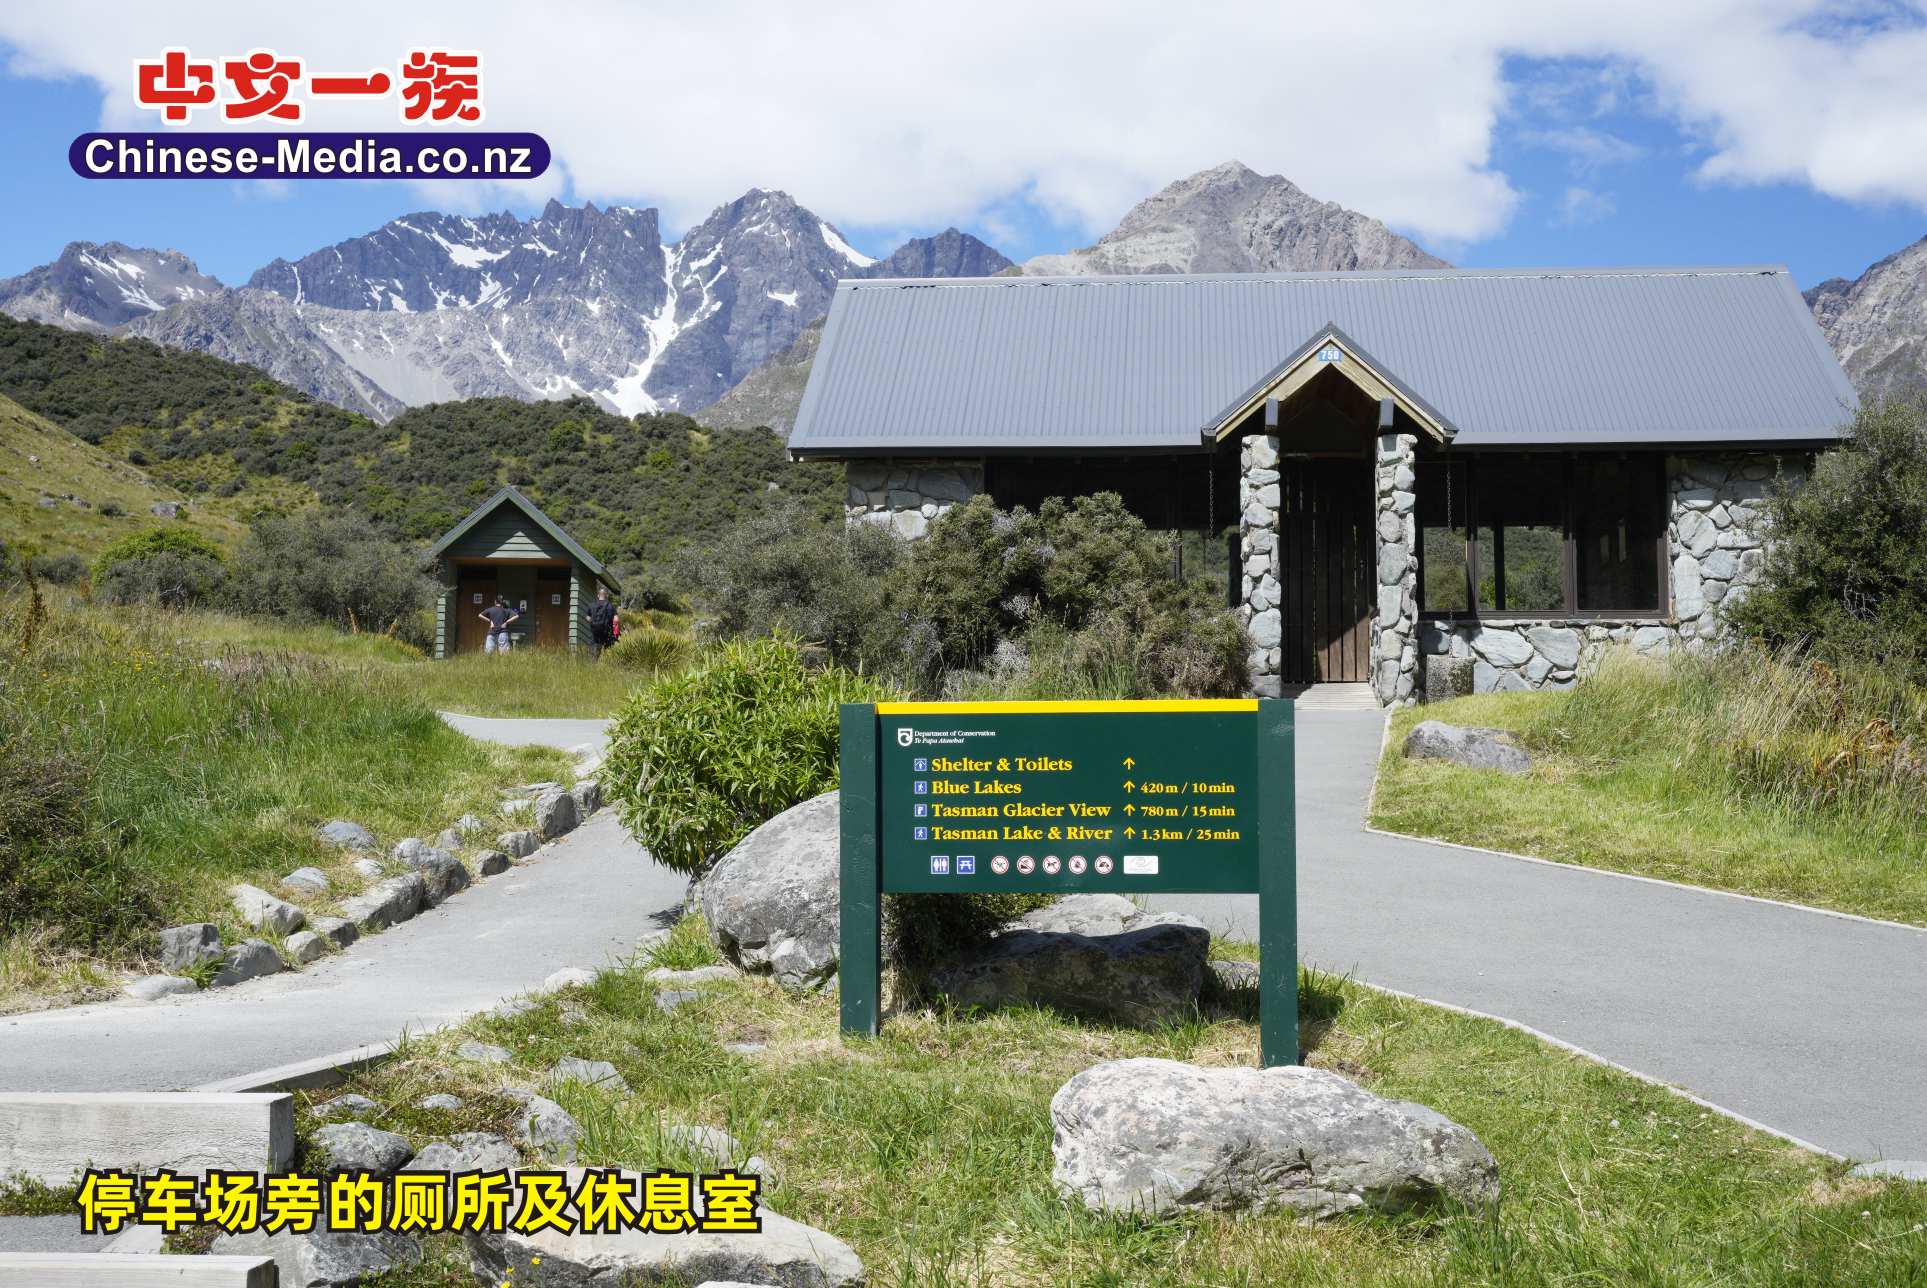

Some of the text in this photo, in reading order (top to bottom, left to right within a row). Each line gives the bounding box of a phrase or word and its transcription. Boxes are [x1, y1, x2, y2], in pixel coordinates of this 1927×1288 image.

[1321, 350, 1340, 360] 750
[914, 730, 949, 738] Department
[931, 757, 1073, 771] Shelter & Toilets
[931, 780, 1022, 794] Blue Lakes
[931, 803, 1112, 817] Tasman Glacier View
[931, 826, 1113, 840] Tasman Lake & River
